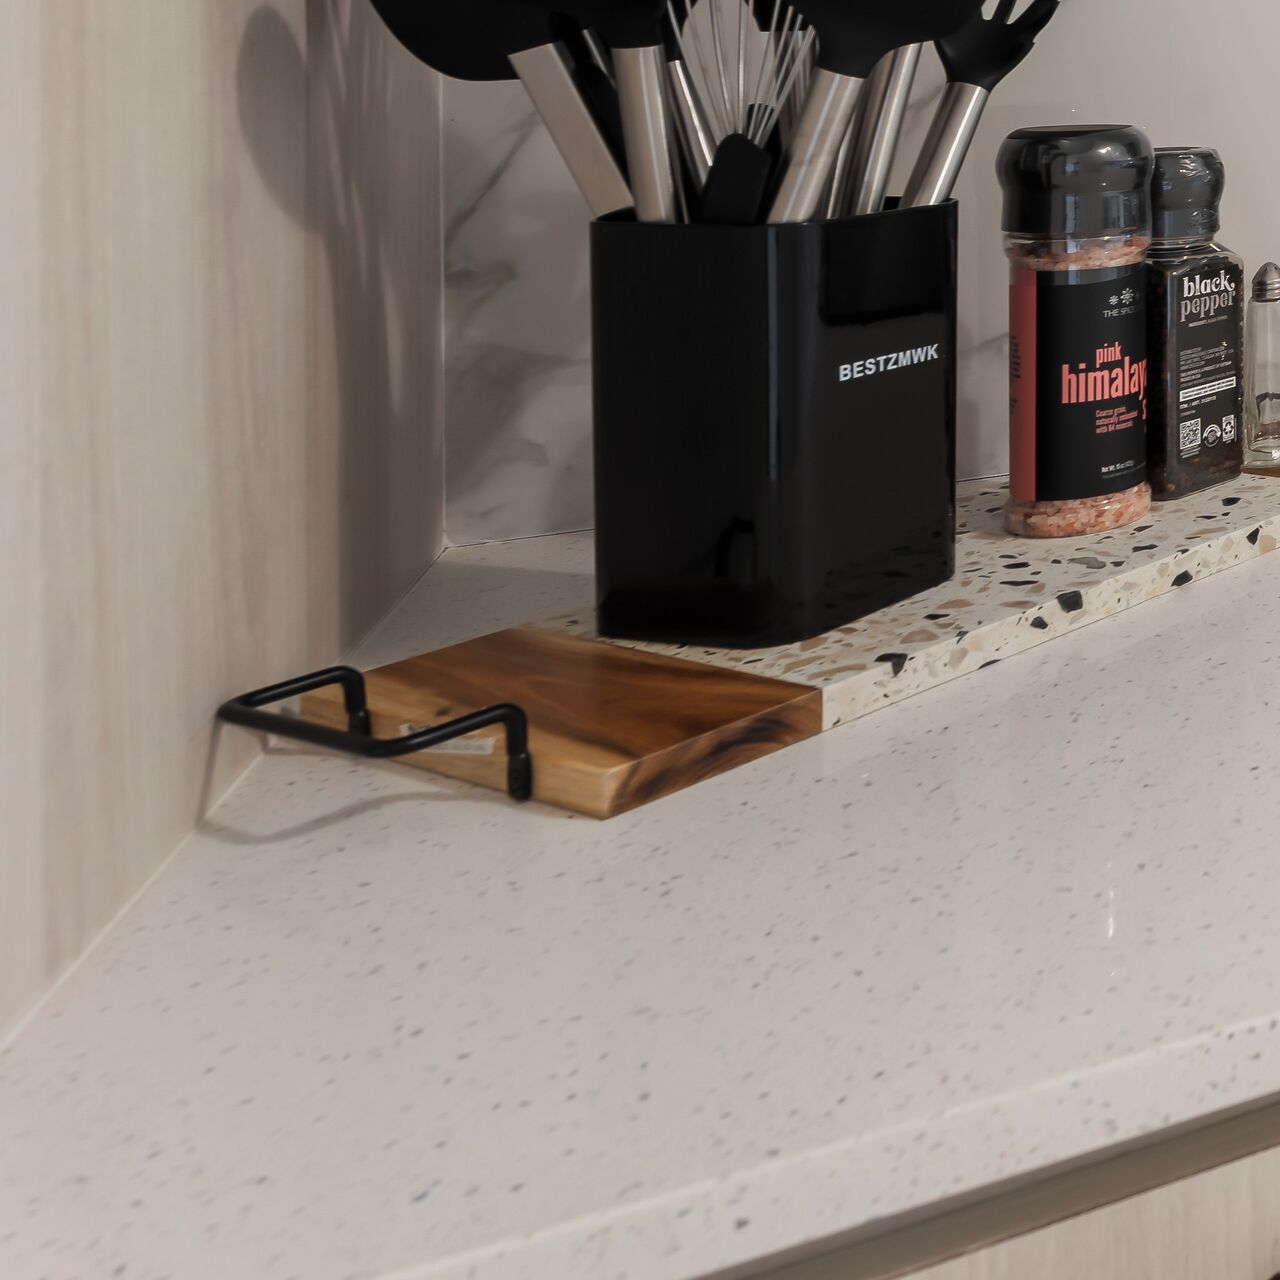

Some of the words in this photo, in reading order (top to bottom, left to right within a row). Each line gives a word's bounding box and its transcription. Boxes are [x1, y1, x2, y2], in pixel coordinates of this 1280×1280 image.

[1182, 269, 1236, 298] black
[1103, 308, 1120, 318] THE
[1180, 290, 1236, 322] pepper
[839, 343, 939, 381] BESTZMWK
[1095, 341, 1122, 369] pink
